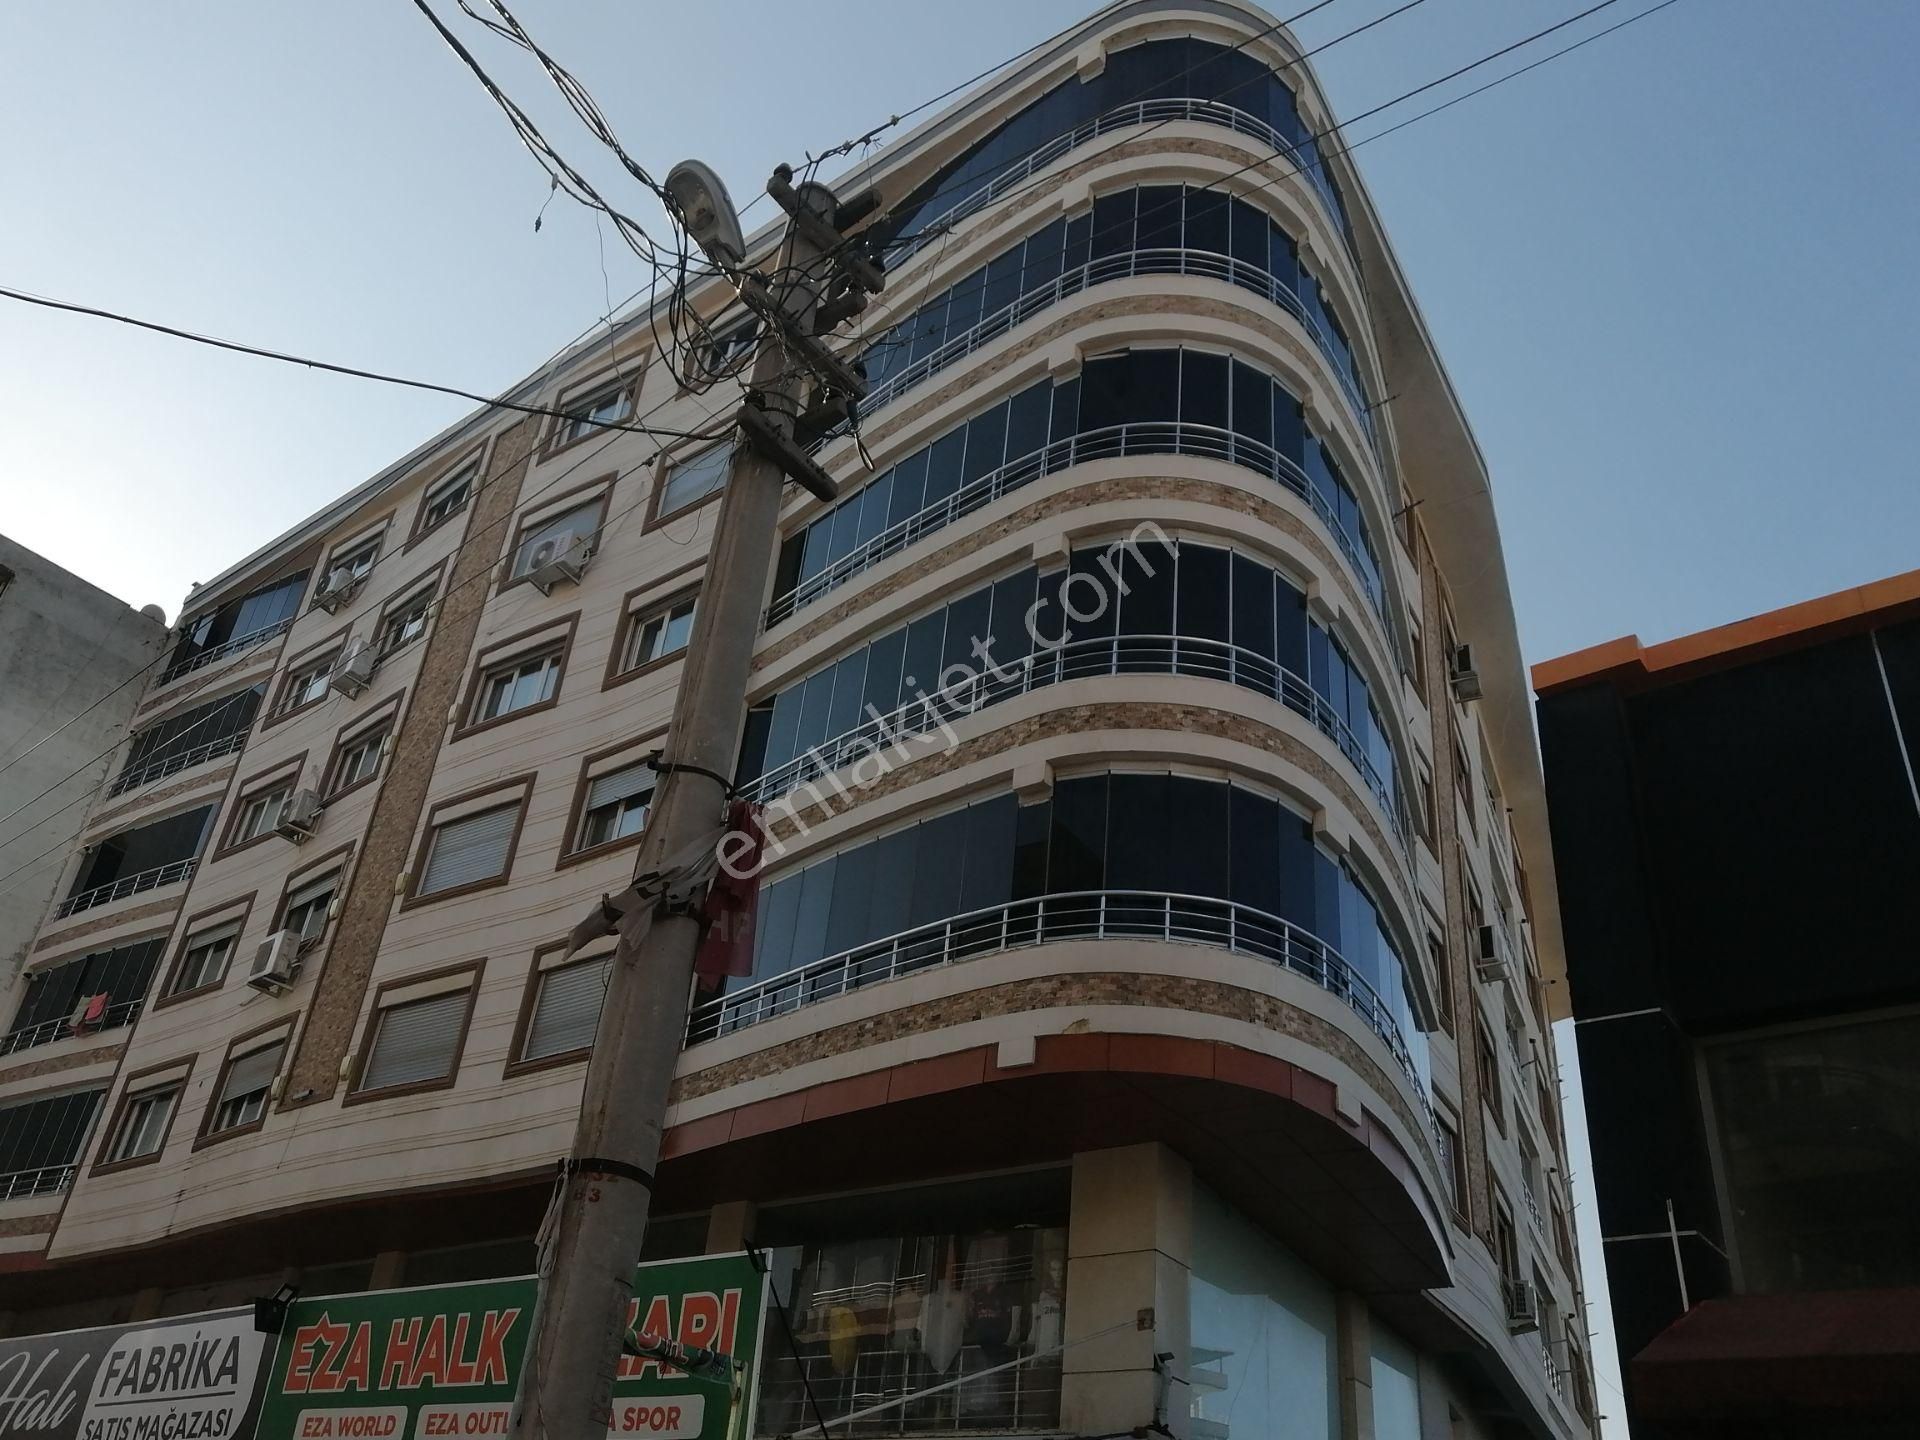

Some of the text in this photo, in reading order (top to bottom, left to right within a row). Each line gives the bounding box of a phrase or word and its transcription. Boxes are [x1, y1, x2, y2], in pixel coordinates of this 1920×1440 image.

[100, 1330, 240, 1398] FABRİKA
[282, 1311, 372, 1394] EZA
[378, 1308, 522, 1390] HALK
[132, 1407, 234, 1440] MAĞAZASI
[302, 1414, 397, 1438] EZA WORLD
[425, 1411, 509, 1435] EZA OUTL
[622, 1406, 681, 1432] SPOR
